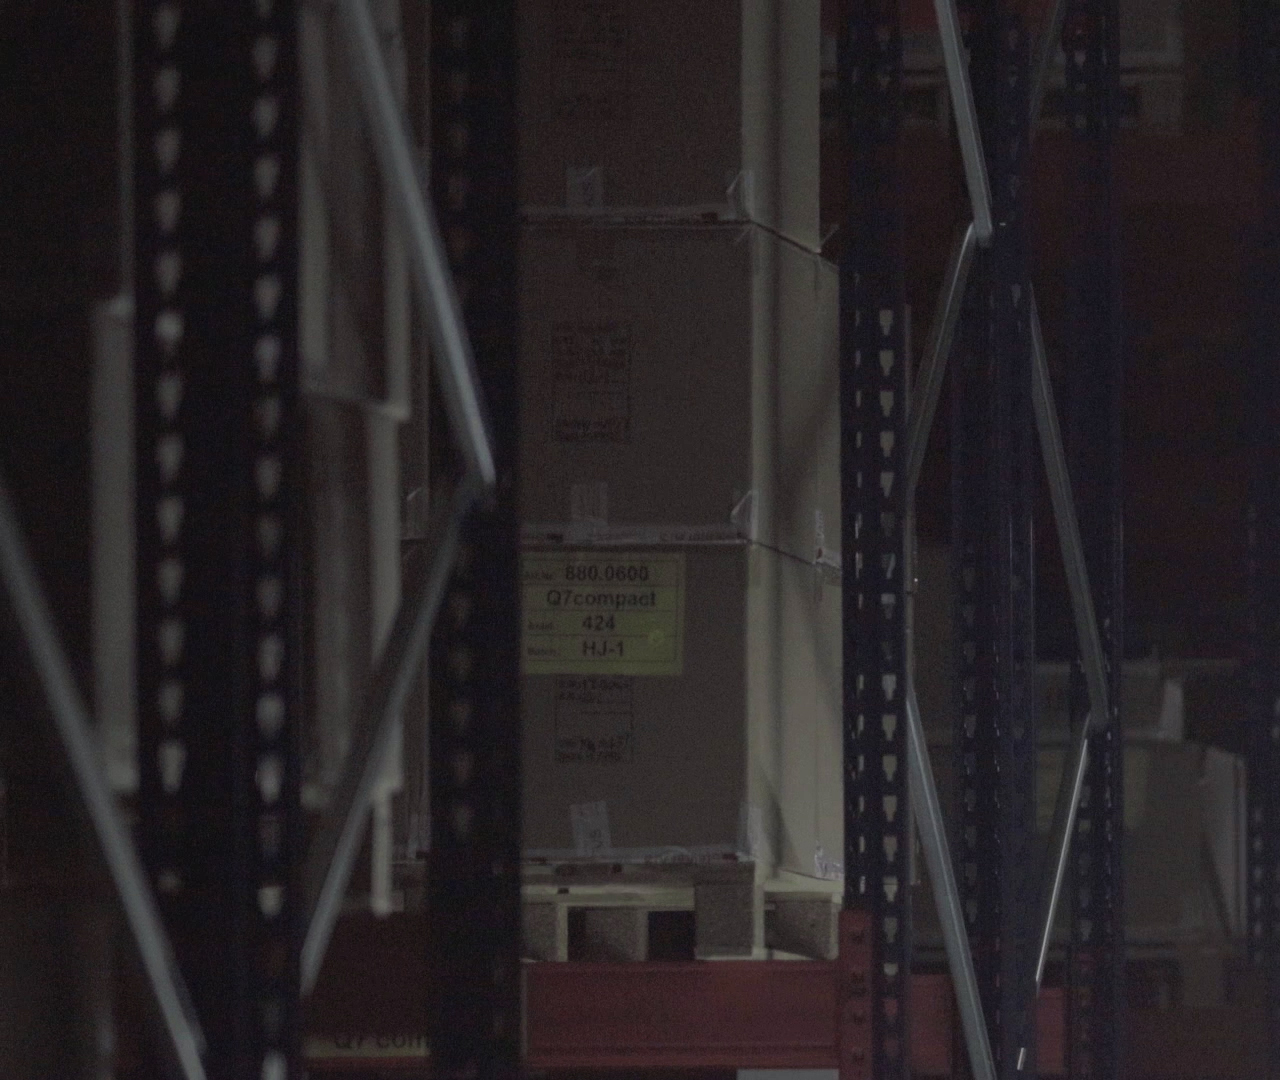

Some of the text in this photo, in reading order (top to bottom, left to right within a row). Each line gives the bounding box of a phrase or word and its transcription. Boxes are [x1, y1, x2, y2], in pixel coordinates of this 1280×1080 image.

[565, 565, 649, 582] 880.0600
[546, 589, 657, 609] Q7compact
[582, 614, 616, 631] 424
[582, 640, 624, 657] HJ-1
